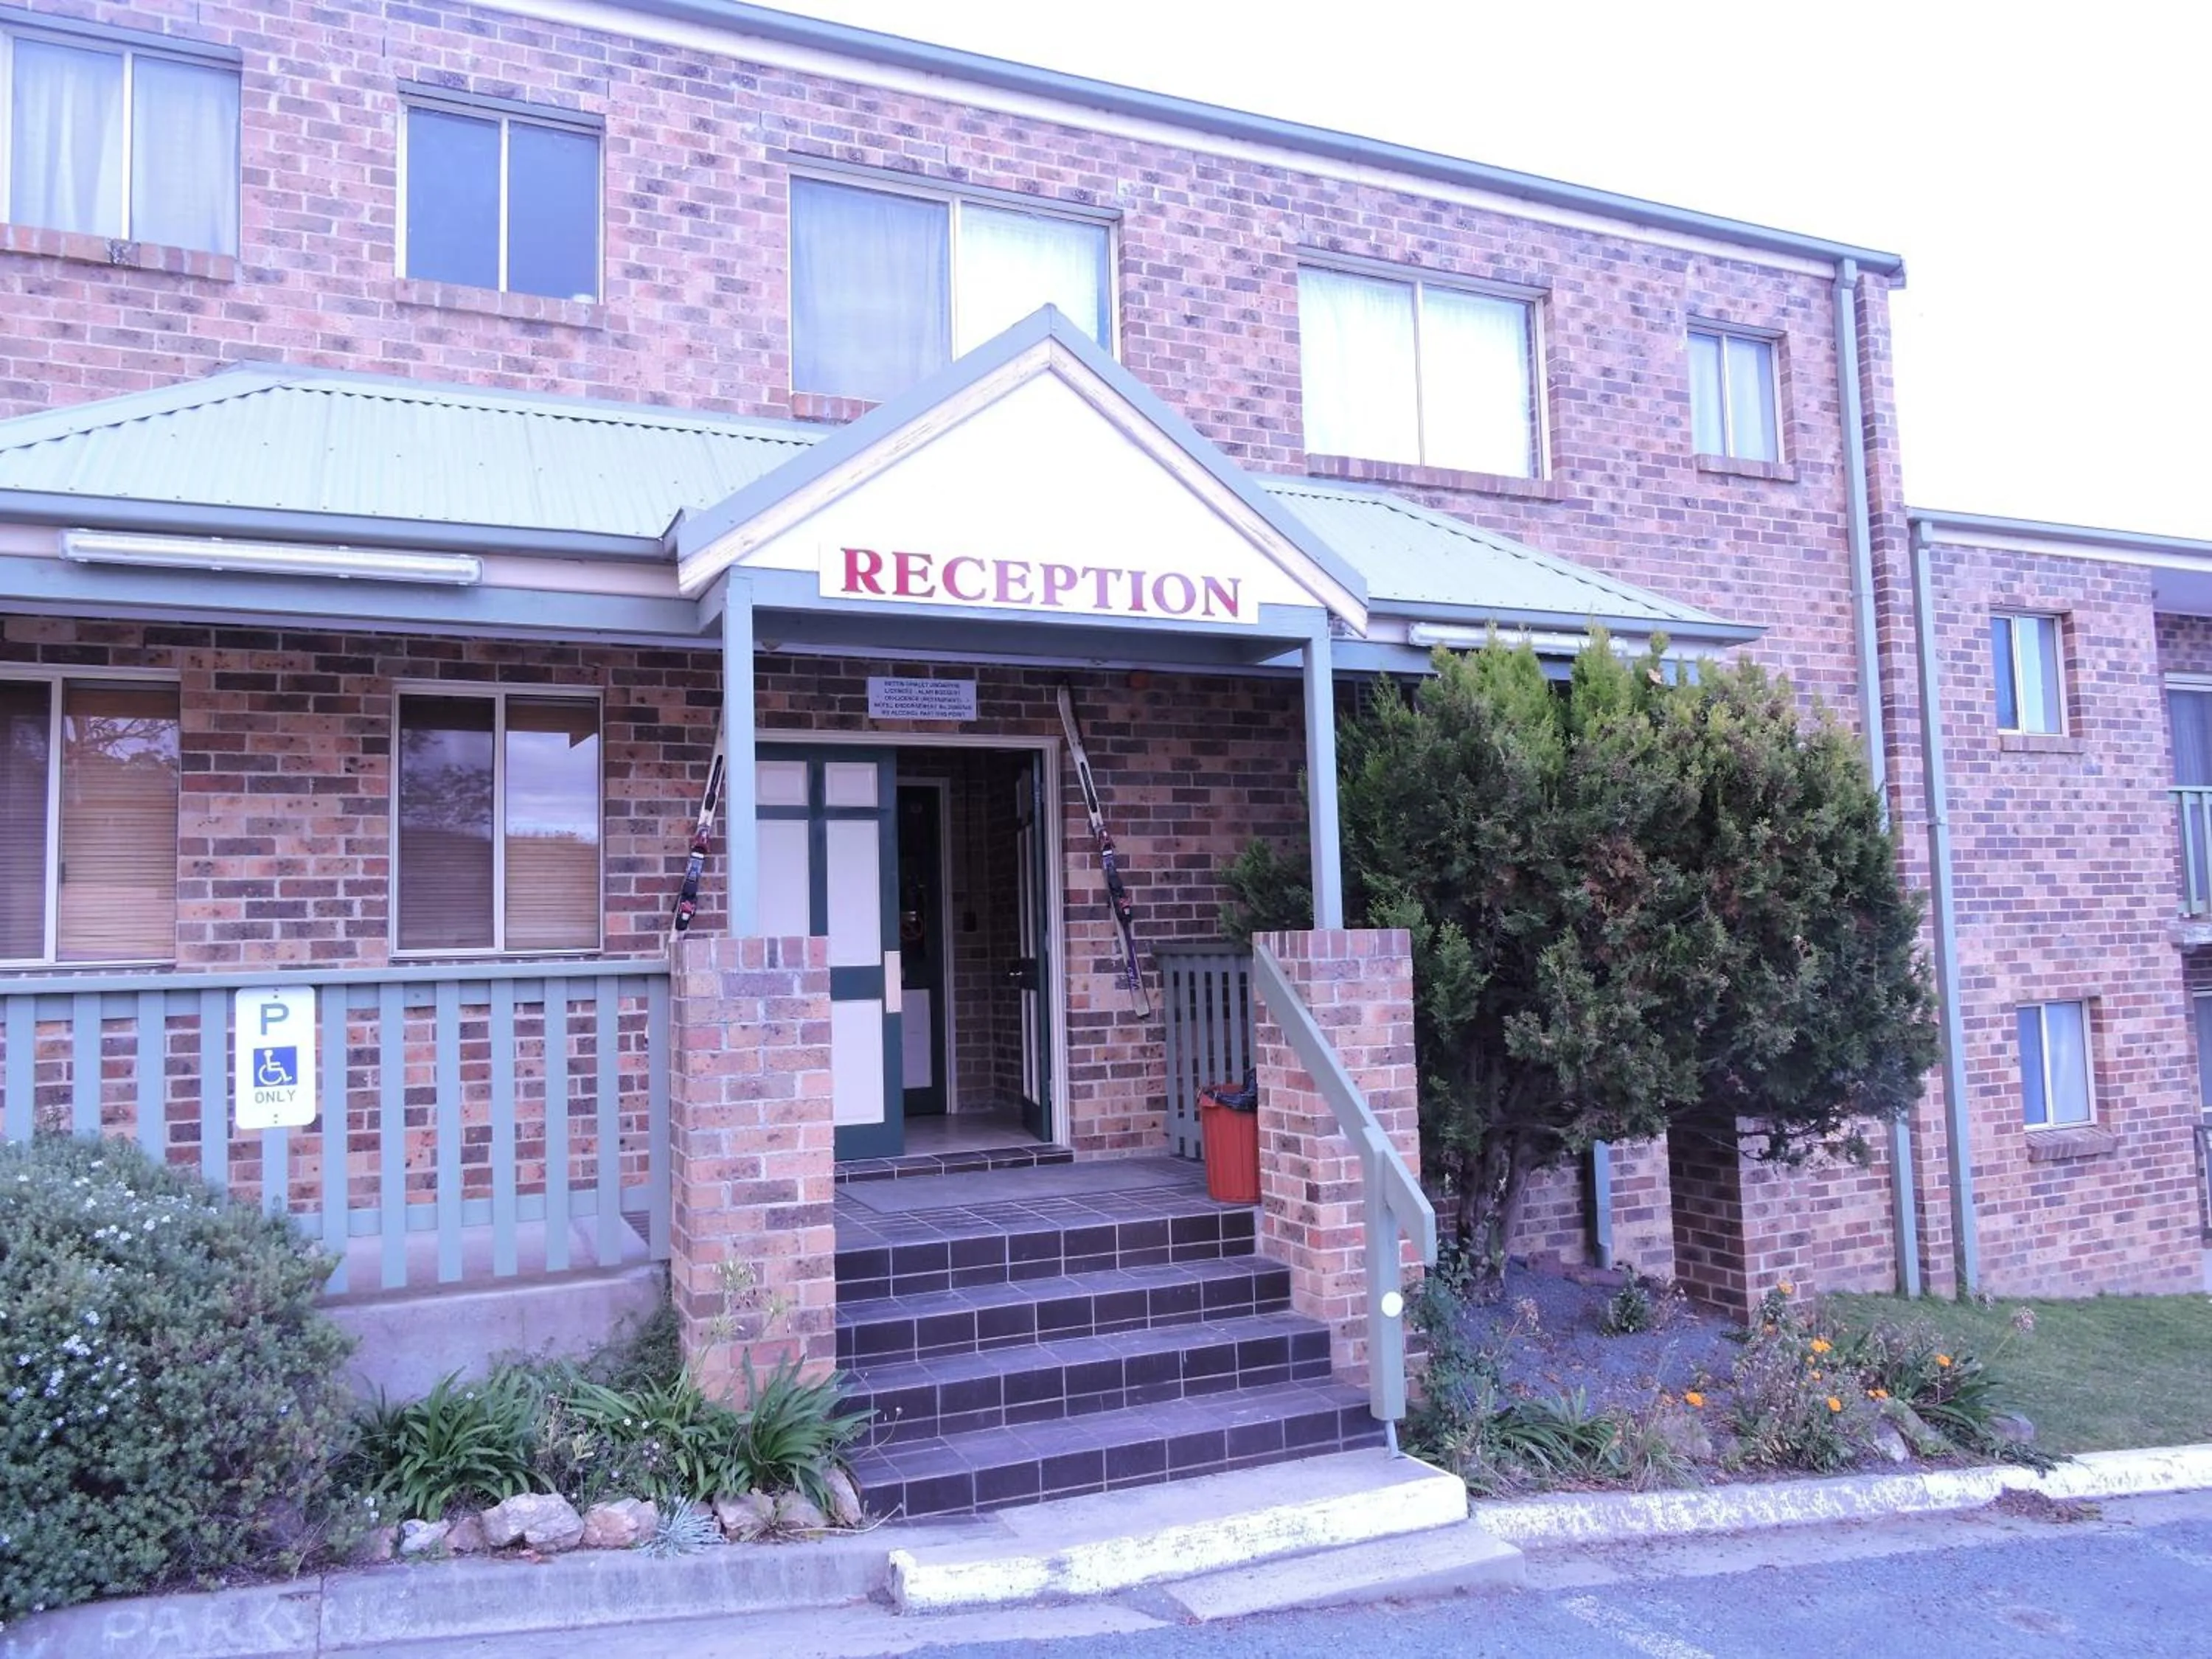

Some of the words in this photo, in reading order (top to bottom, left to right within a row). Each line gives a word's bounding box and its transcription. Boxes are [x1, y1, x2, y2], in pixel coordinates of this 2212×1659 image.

[840, 547, 1242, 618] RECEPTION
[260, 1002, 290, 1036] P
[254, 1089, 296, 1105] ONLY
